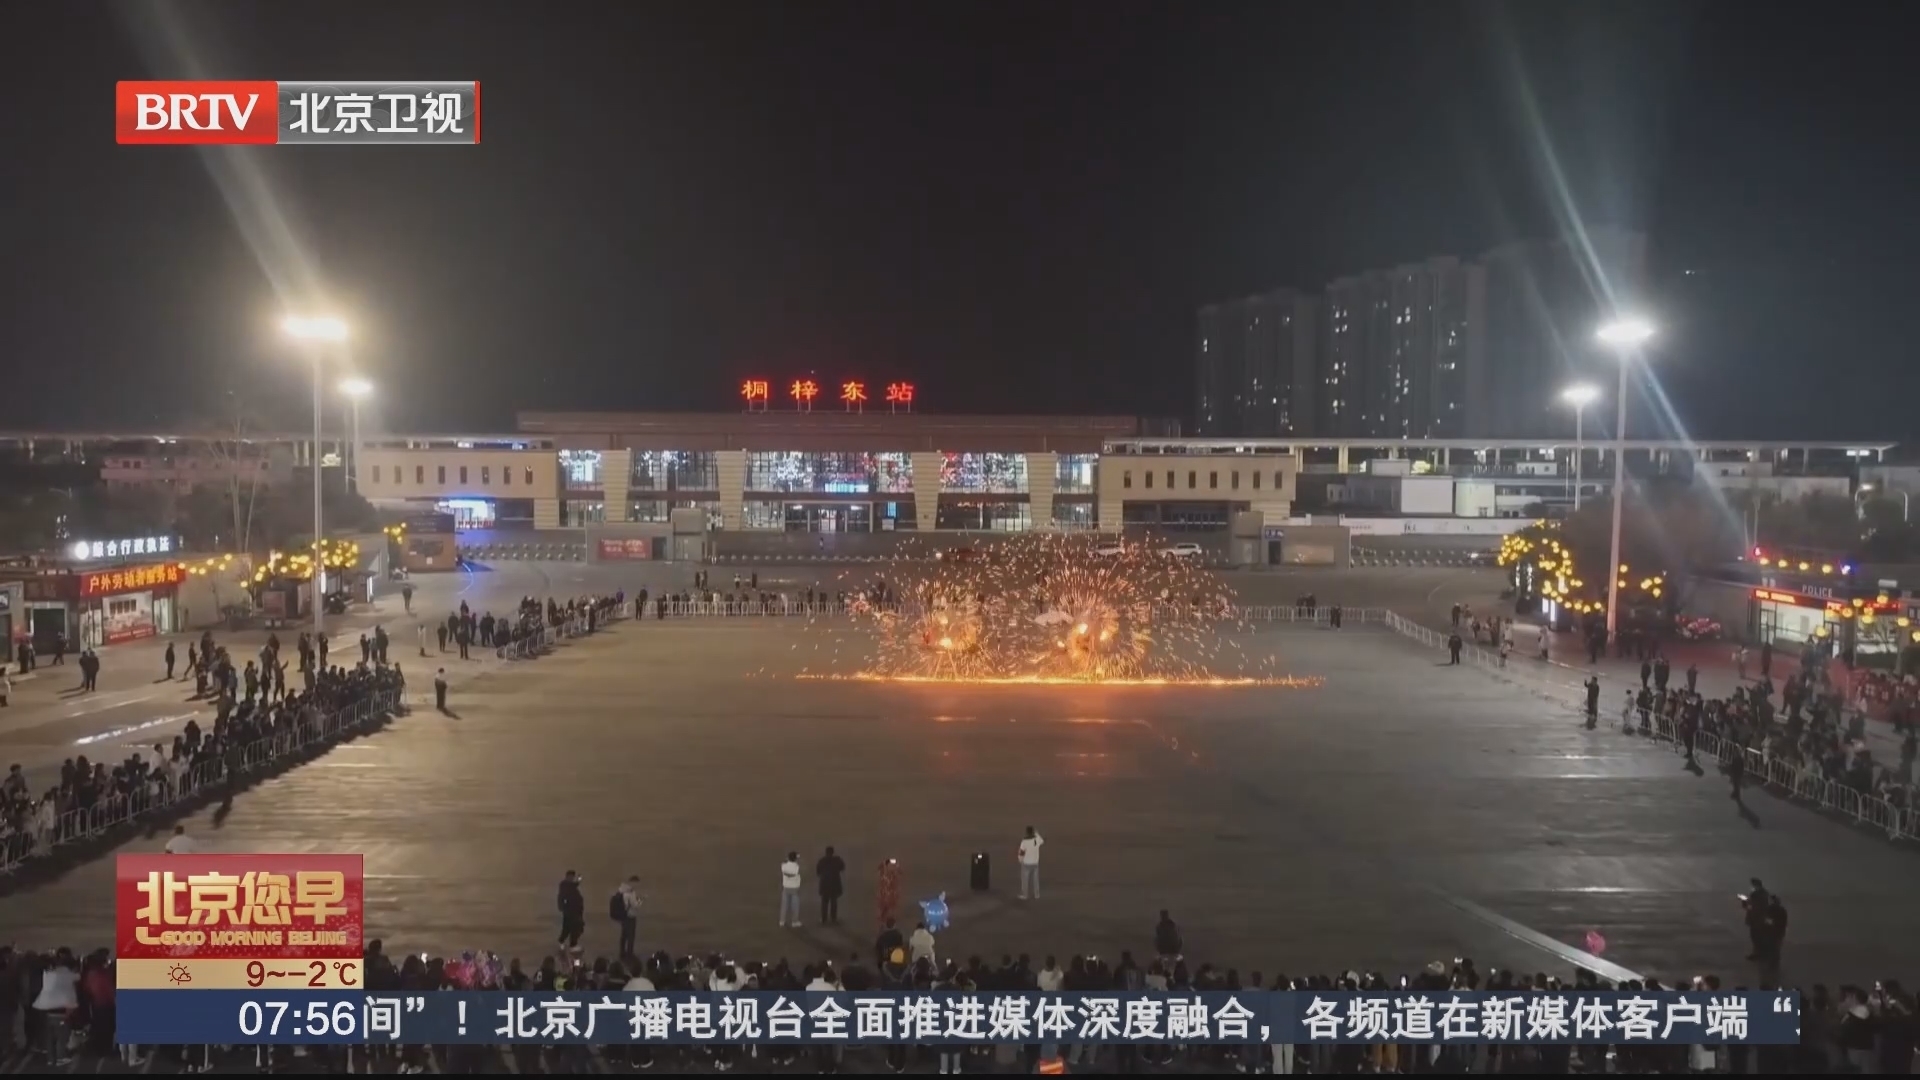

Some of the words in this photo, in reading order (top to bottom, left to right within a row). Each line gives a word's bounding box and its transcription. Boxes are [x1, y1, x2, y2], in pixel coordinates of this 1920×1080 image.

[741, 379, 914, 401] 桐梓东站
[89, 563, 178, 593] 户外劳动者服务站
[1802, 584, 1833, 598] POLICE
